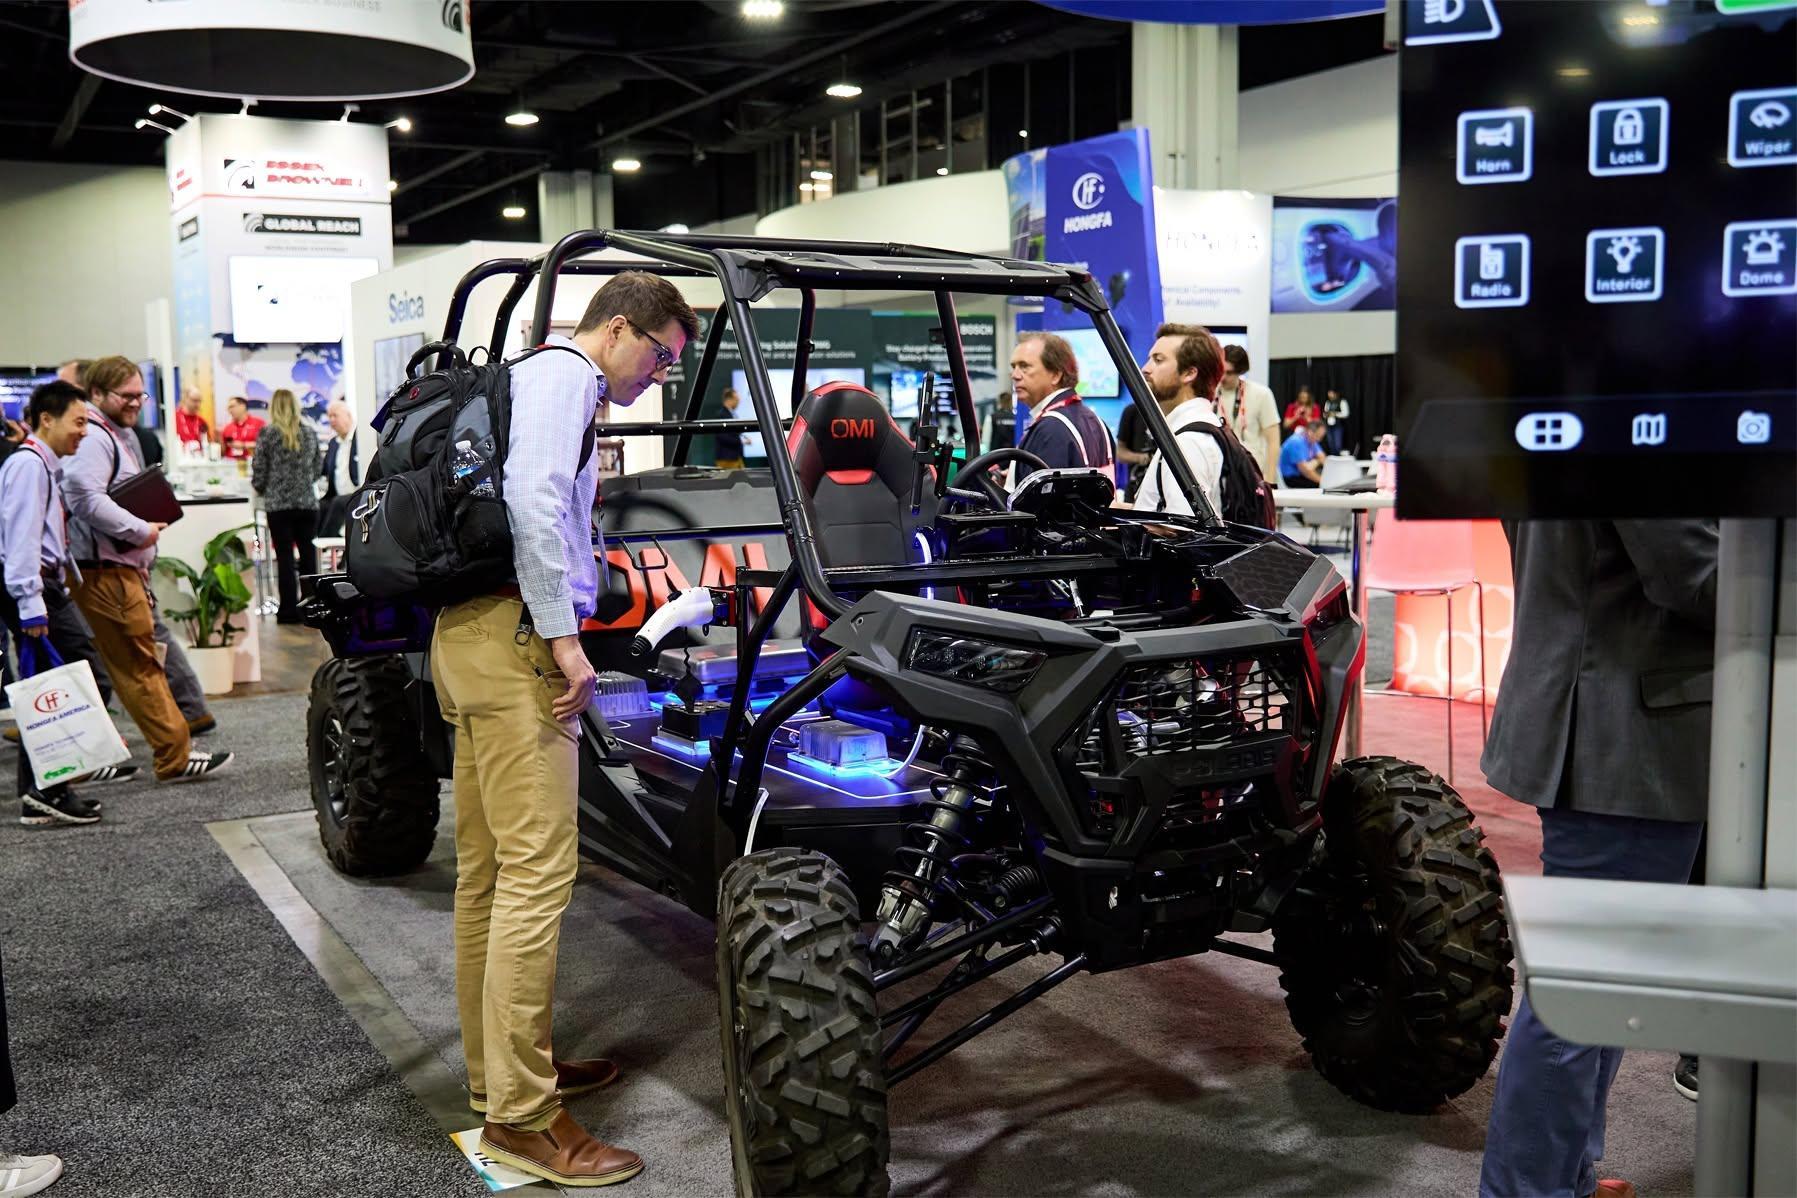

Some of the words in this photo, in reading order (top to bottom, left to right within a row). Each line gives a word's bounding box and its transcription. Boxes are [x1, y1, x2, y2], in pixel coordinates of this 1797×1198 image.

[1744, 140, 1792, 157] Wiper
[1475, 158, 1512, 173] Horn
[1609, 150, 1645, 165] Lock
[264, 217, 316, 232] GLOBAL
[316, 219, 360, 233] REACH
[1063, 210, 1113, 234] HONGFA
[1596, 277, 1652, 292] Interior
[1739, 271, 1785, 286] Dome
[1470, 282, 1512, 298] Radio
[389, 290, 424, 324] Seica
[960, 322, 994, 336] BOSCH
[831, 418, 875, 439] OMI
[59, 704, 91, 720] AMERICA
